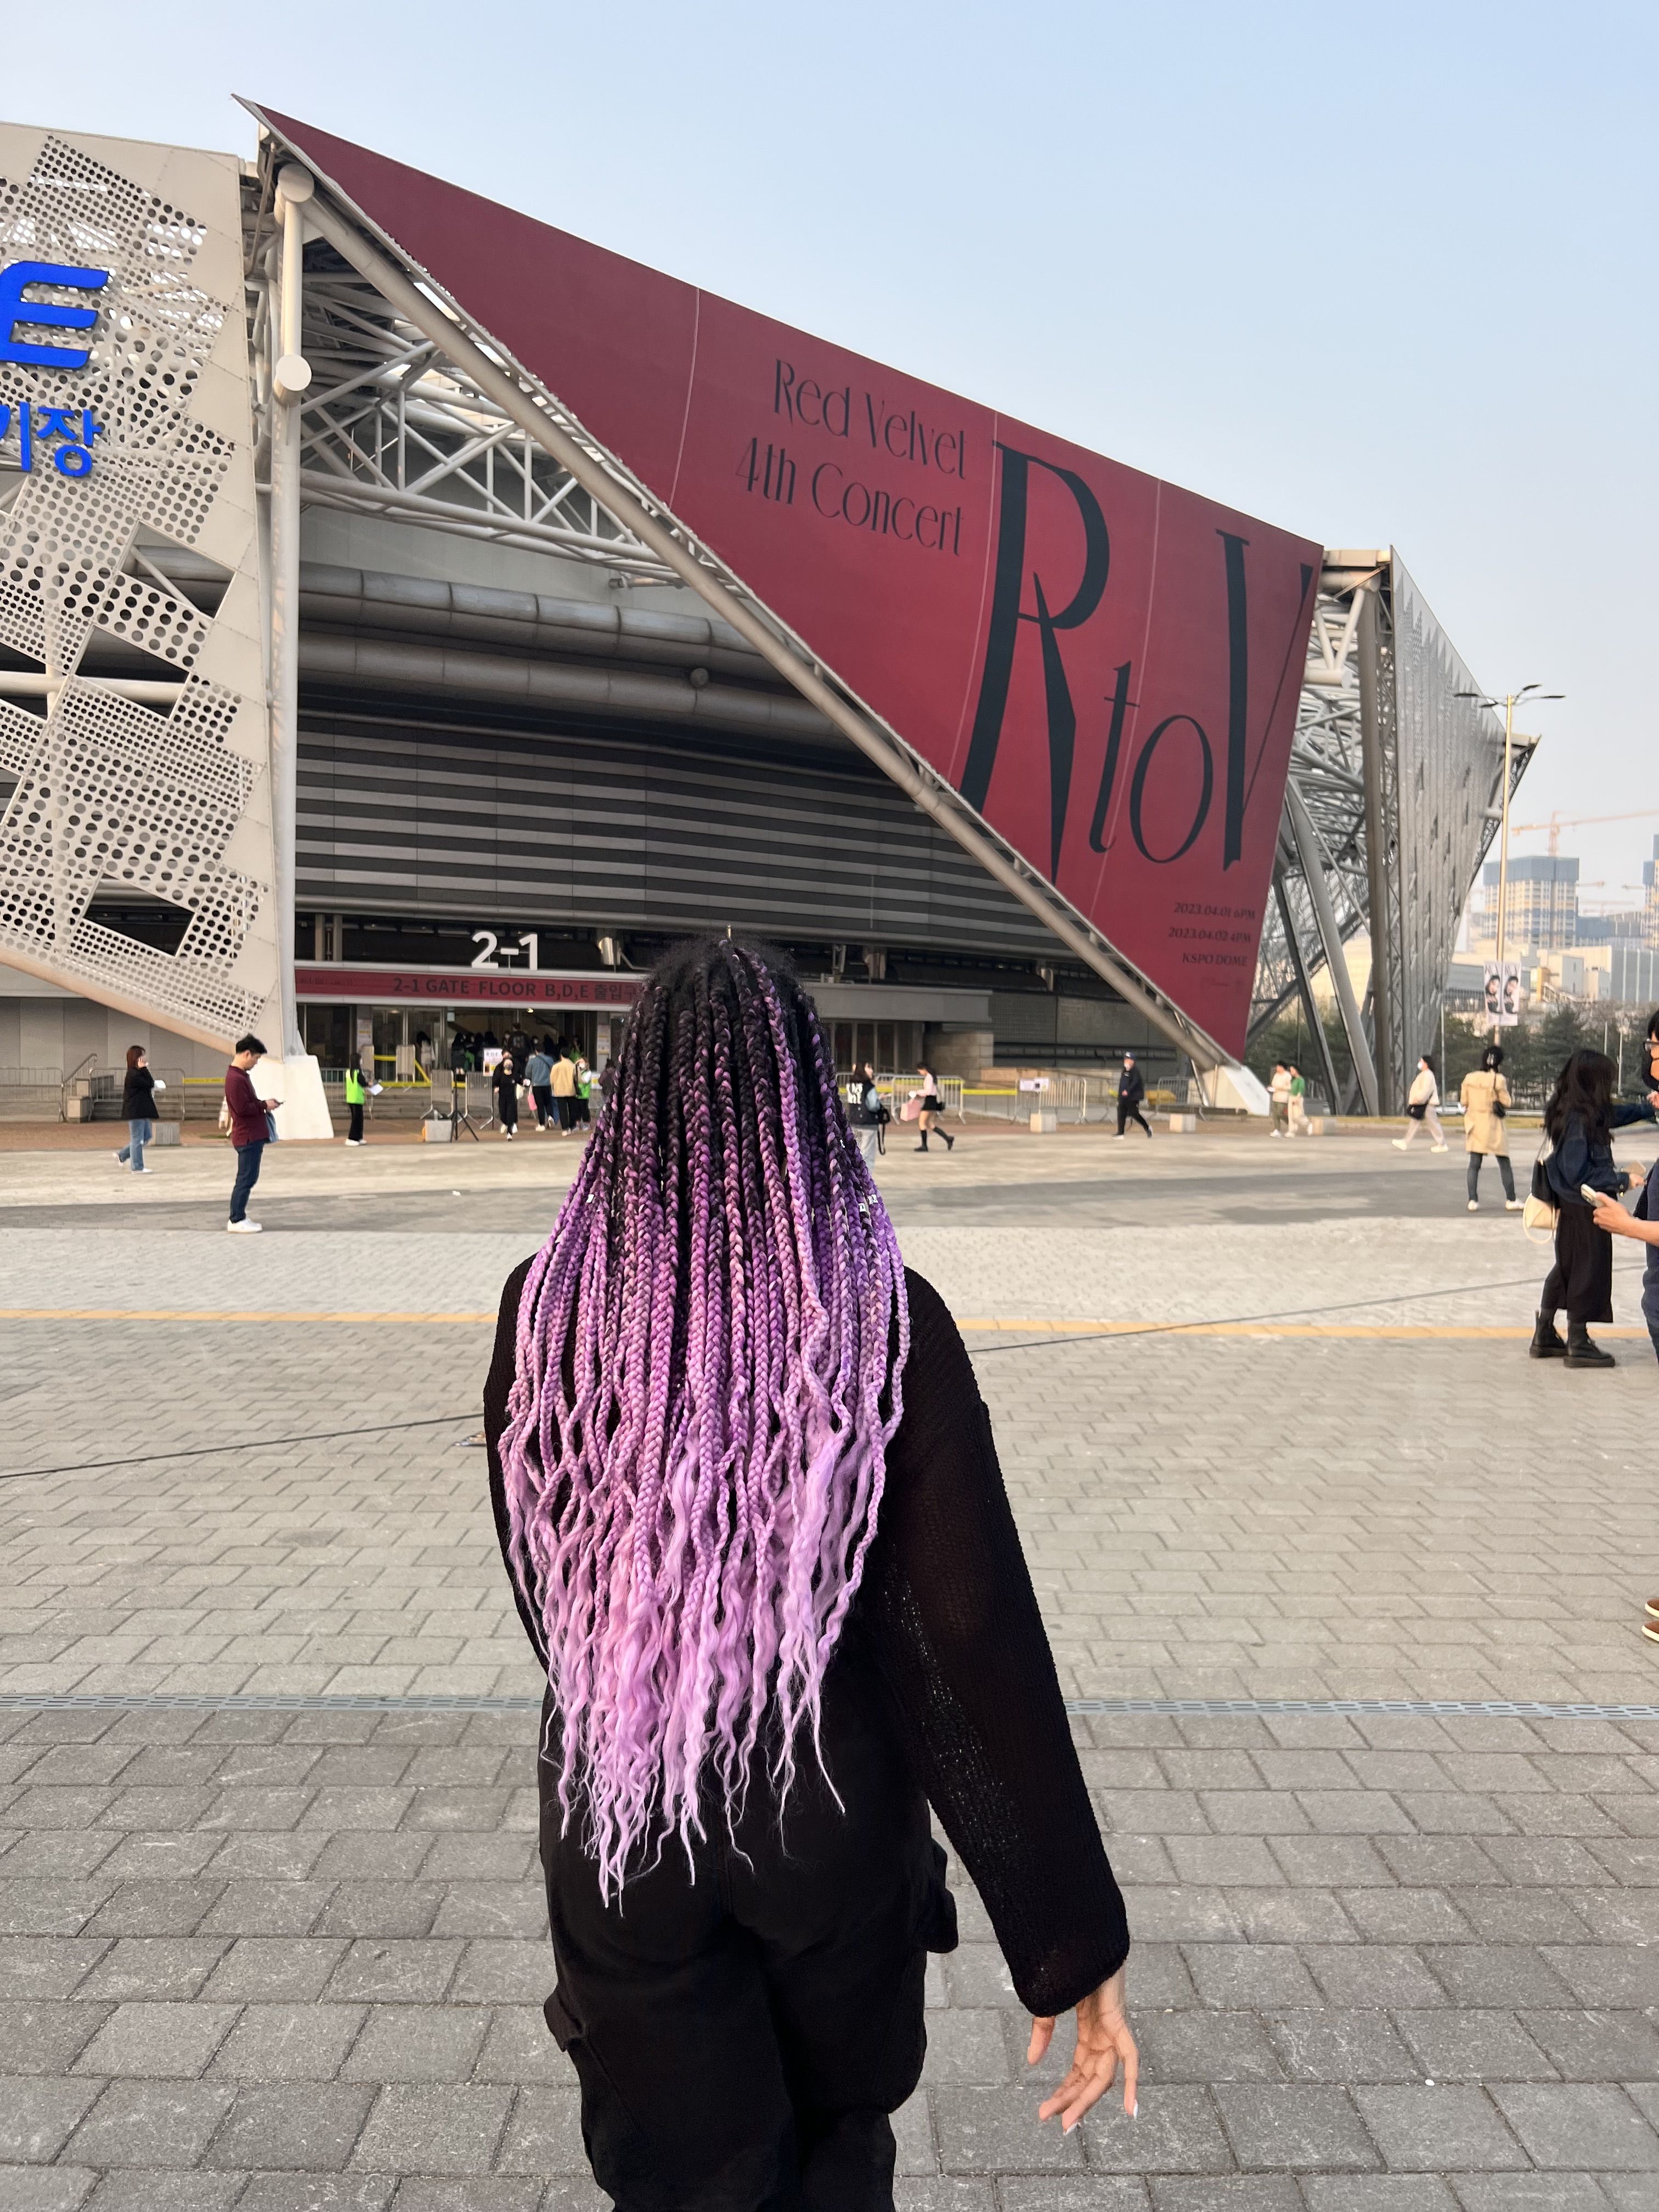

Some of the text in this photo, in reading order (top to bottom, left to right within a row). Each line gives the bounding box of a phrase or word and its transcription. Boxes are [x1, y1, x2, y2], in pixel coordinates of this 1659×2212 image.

[773, 359, 966, 479] Red Velvet
[735, 437, 964, 556] 4th Concert
[1174, 902, 1255, 919] 2023.04.01 6PM
[1168, 927, 1251, 943] 2023.04.02 4PM
[471, 931, 538, 971] 2-1
[1183, 953, 1247, 967] KSPO DOME
[393, 978, 419, 992] 2-1
[426, 979, 470, 994] GATE
[478, 981, 536, 996] FLOOR
